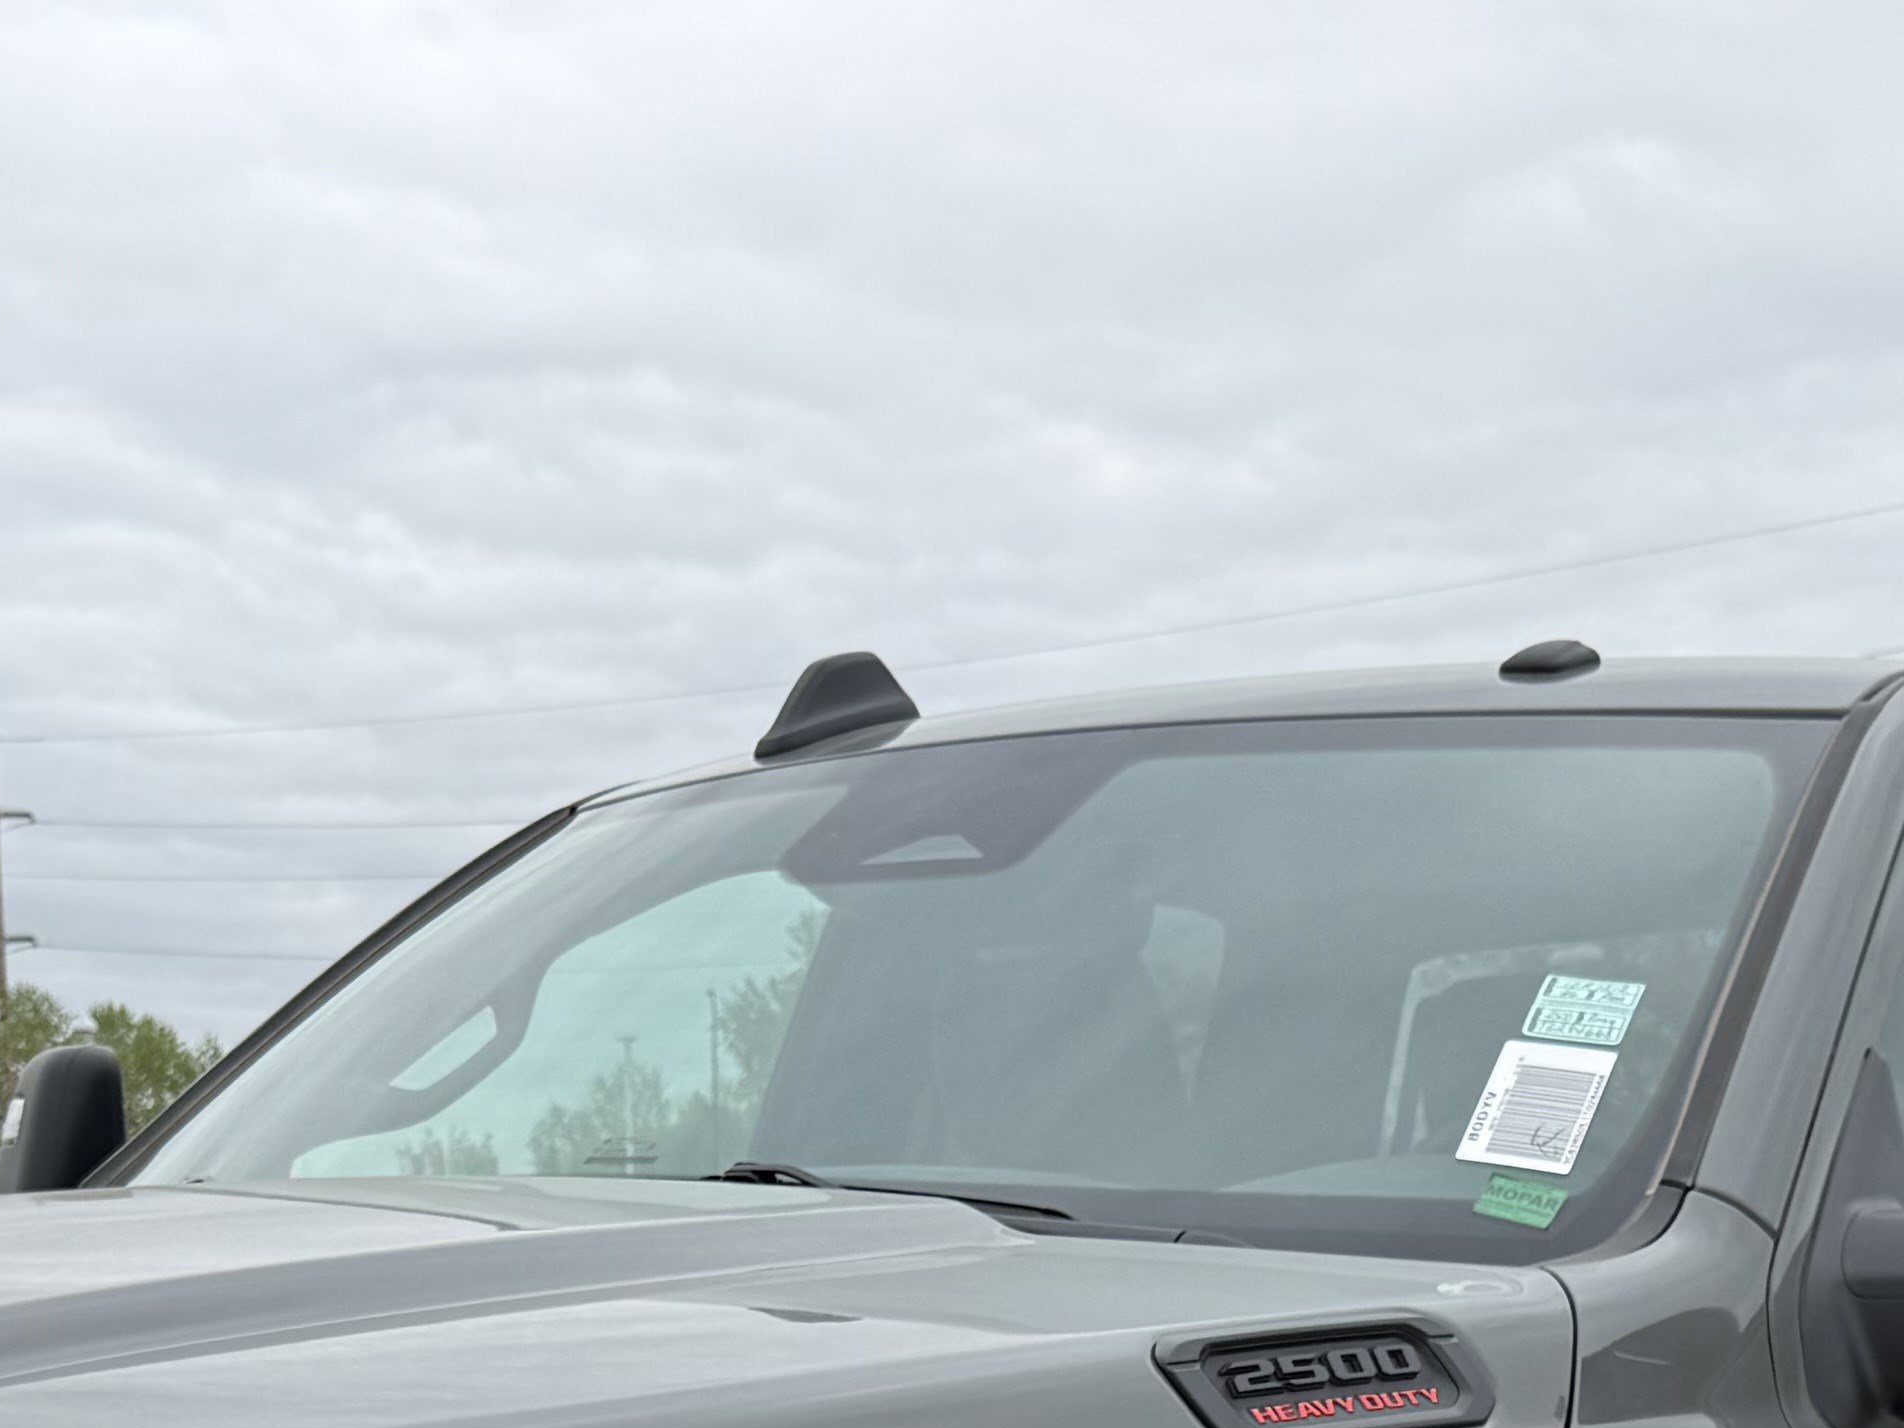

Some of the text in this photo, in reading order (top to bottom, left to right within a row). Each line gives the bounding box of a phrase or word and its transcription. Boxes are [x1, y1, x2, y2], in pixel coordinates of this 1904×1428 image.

[1218, 1344, 1423, 1399] 2500
[1250, 1388, 1440, 1425] HEAVY DUTY
